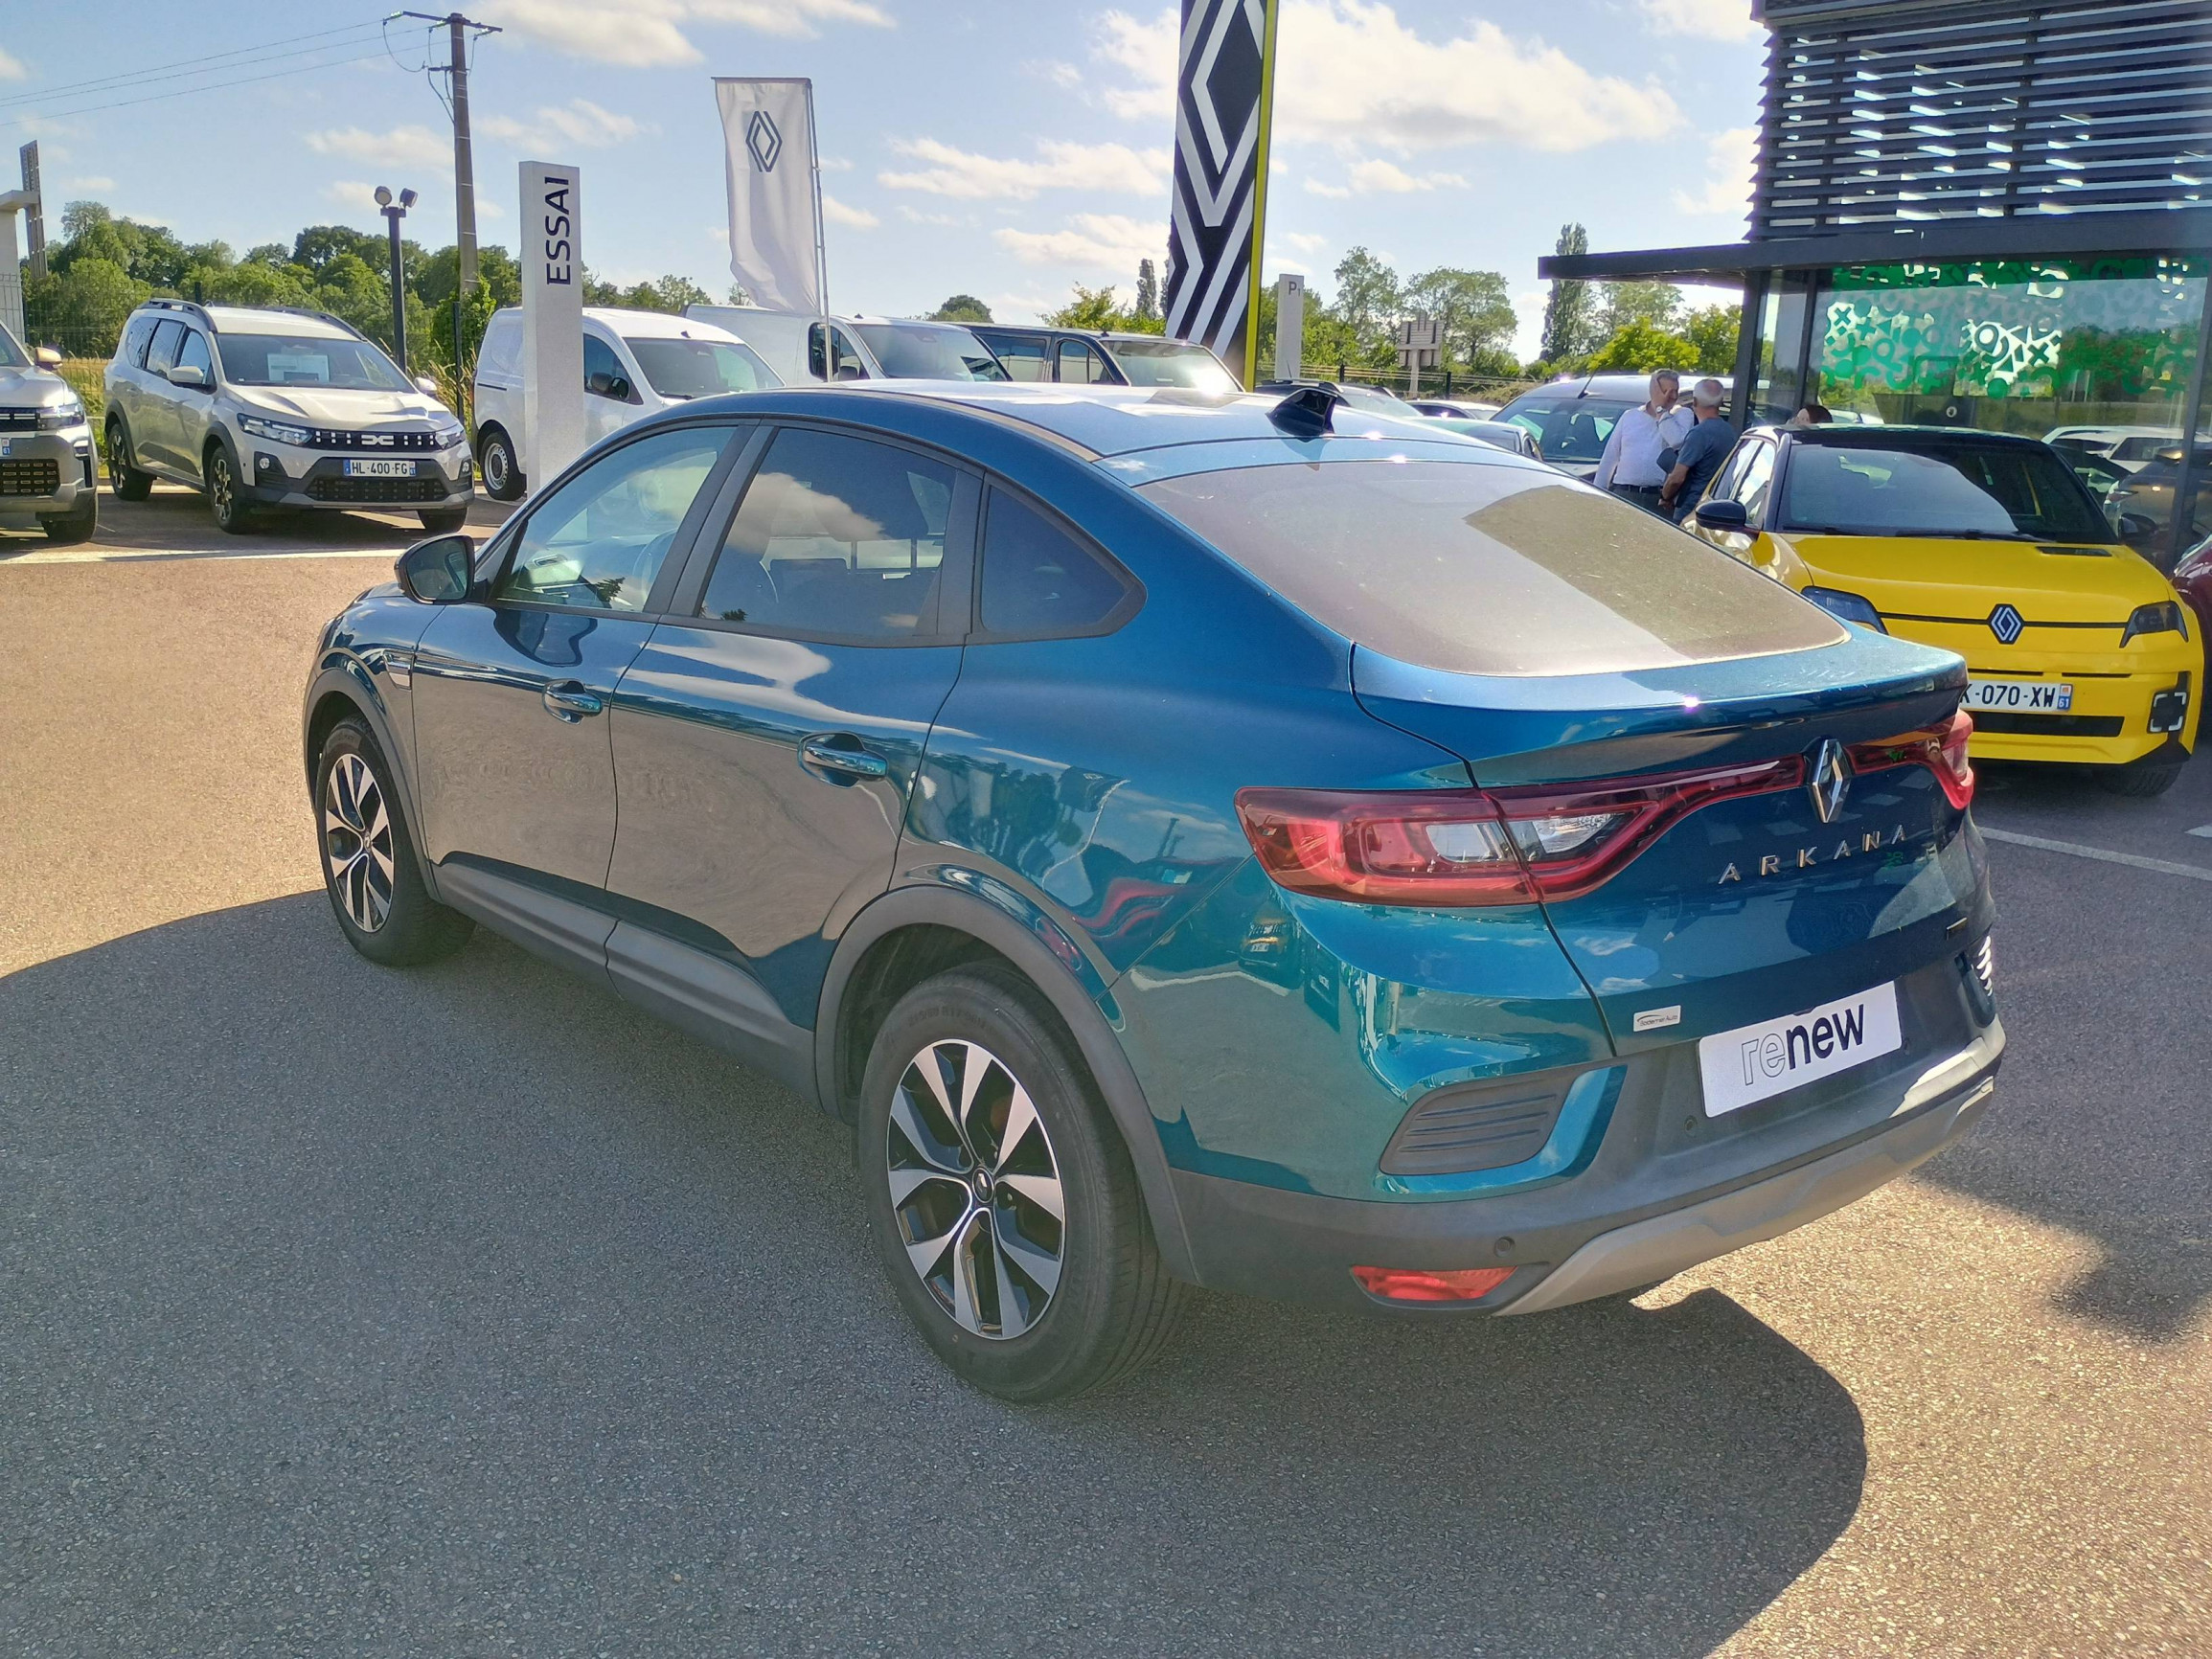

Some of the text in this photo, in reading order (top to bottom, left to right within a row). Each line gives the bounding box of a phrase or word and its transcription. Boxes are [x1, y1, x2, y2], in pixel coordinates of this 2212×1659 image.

[544, 176, 571, 285] ESSAI
[2058, 697, 2069, 708] 61
[1718, 824, 1907, 886] ARKANA
[1741, 1003, 1864, 1086] renew
